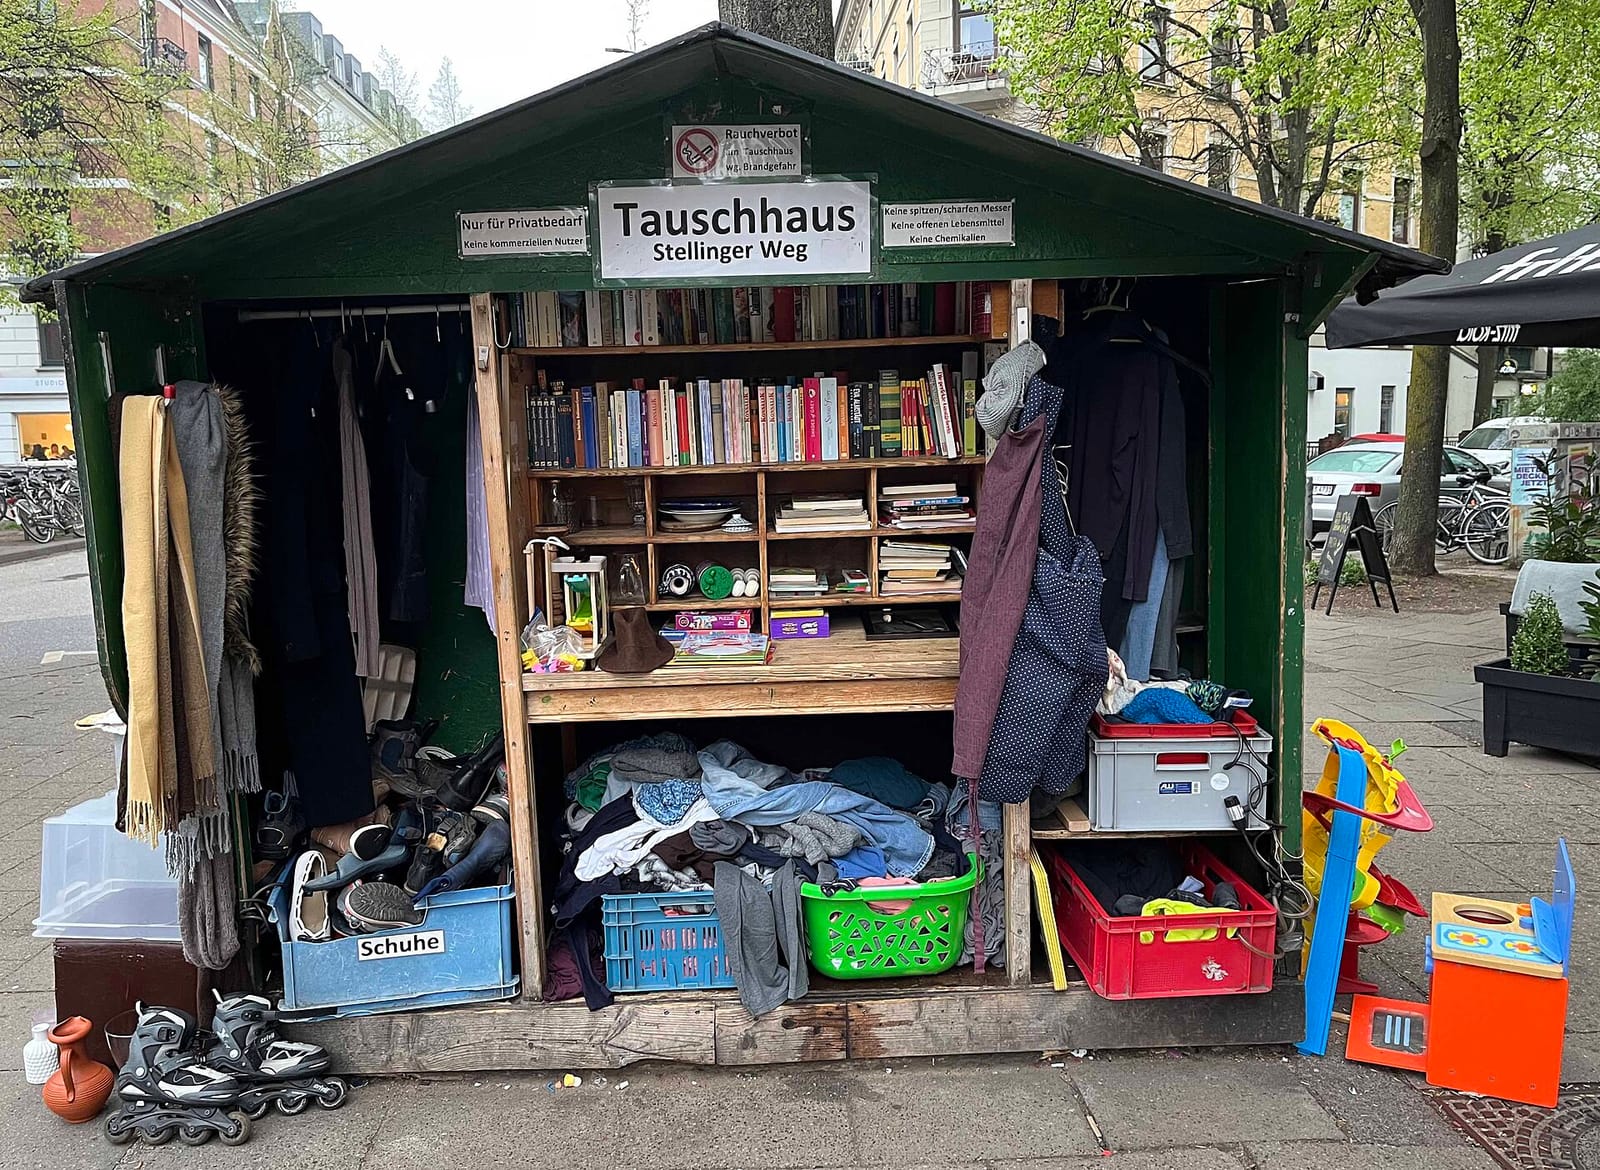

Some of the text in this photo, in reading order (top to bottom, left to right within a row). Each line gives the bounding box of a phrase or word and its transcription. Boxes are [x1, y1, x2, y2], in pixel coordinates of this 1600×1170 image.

[725, 128, 798, 140] Rauchverbot
[744, 146, 794, 156] Tauschhaus
[725, 161, 797, 172] wg. Brandgefahr
[884, 203, 1011, 217] Keine spitzen/scharfen Messer
[462, 215, 583, 231] Nur für Privatbedarf
[613, 197, 856, 237] Tauschhaus
[891, 217, 1005, 230] Keine offenen Lebensmittel
[464, 236, 584, 249] Keine kommerziellen Nutzer
[909, 233, 986, 244] Keine Chemikalien
[653, 239, 808, 264] Stellinger Weg
[361, 934, 440, 957] Schuhe
